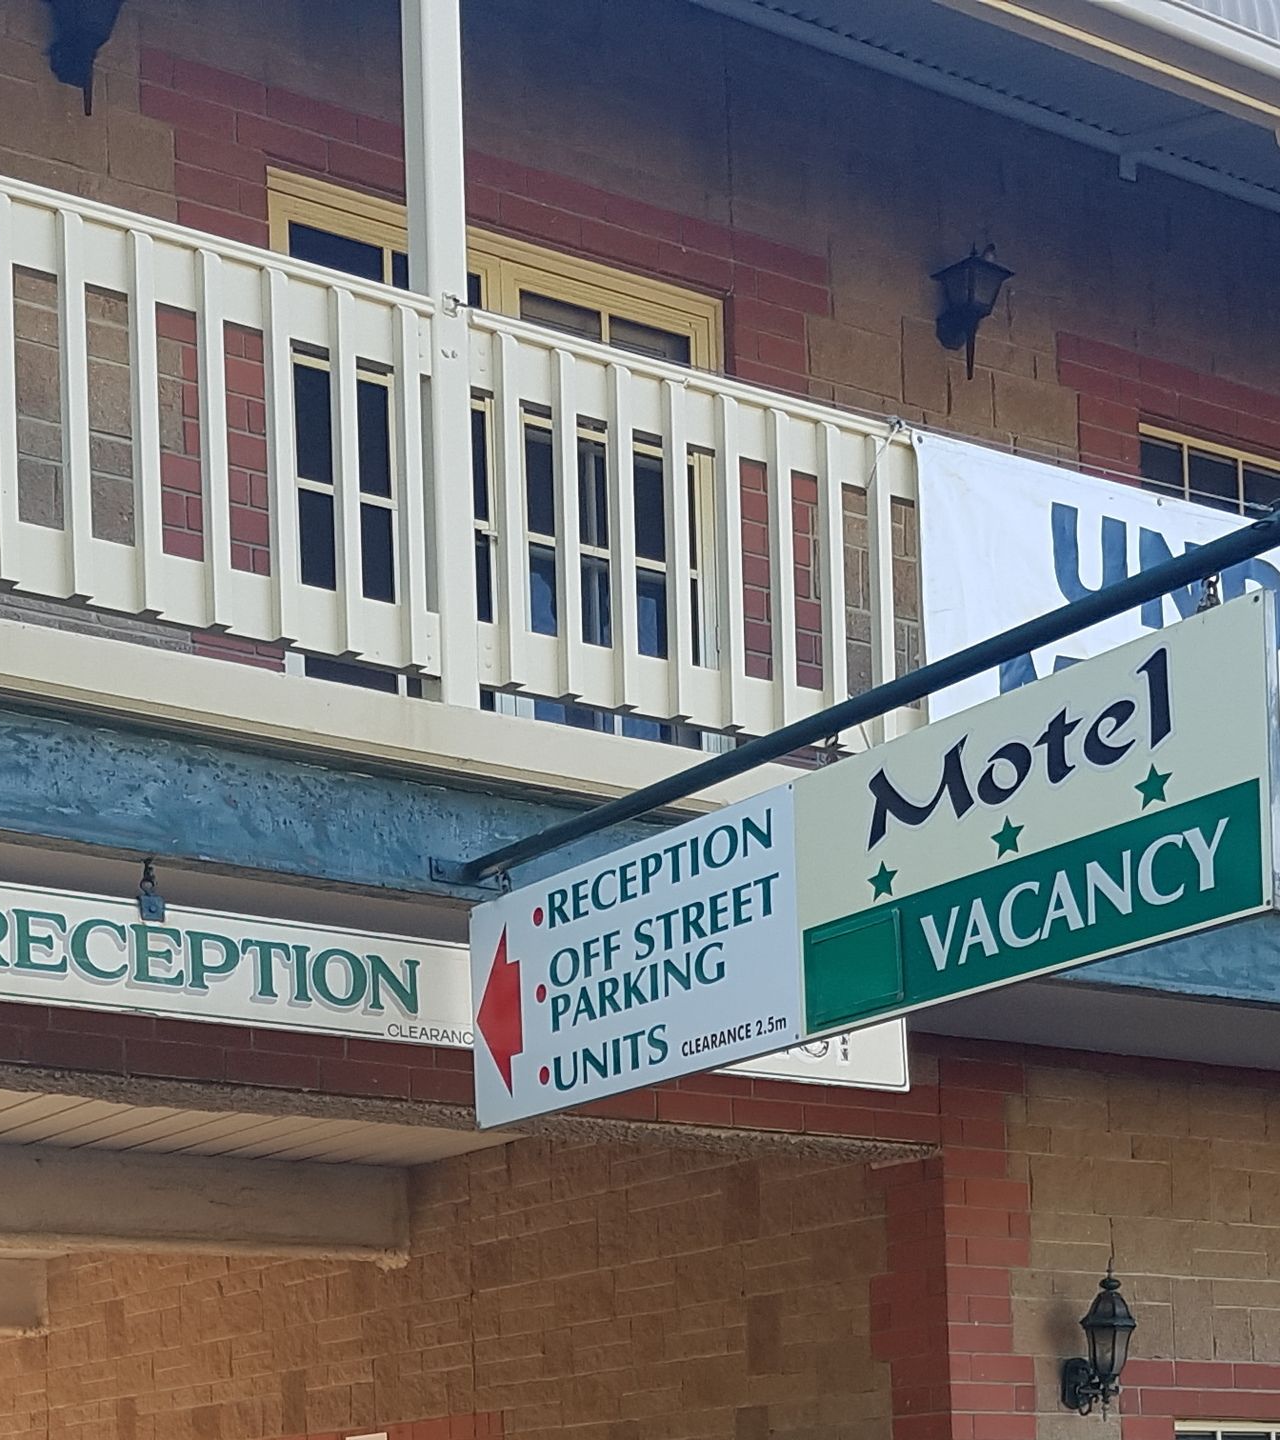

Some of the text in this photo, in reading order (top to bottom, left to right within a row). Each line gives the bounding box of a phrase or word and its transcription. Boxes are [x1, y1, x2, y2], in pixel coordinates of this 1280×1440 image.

[868, 646, 1173, 852] Motel
[547, 808, 774, 930] RECEPTION
[919, 816, 1231, 972] VACANCY
[549, 872, 780, 989] OFF STREET
[386, 1023, 475, 1046] CLEARANC
[550, 941, 726, 1034] PARKING
[681, 1022, 752, 1057] CLEARANCE
[755, 1015, 788, 1037] 2.5m
[552, 1023, 669, 1092] UNITS
